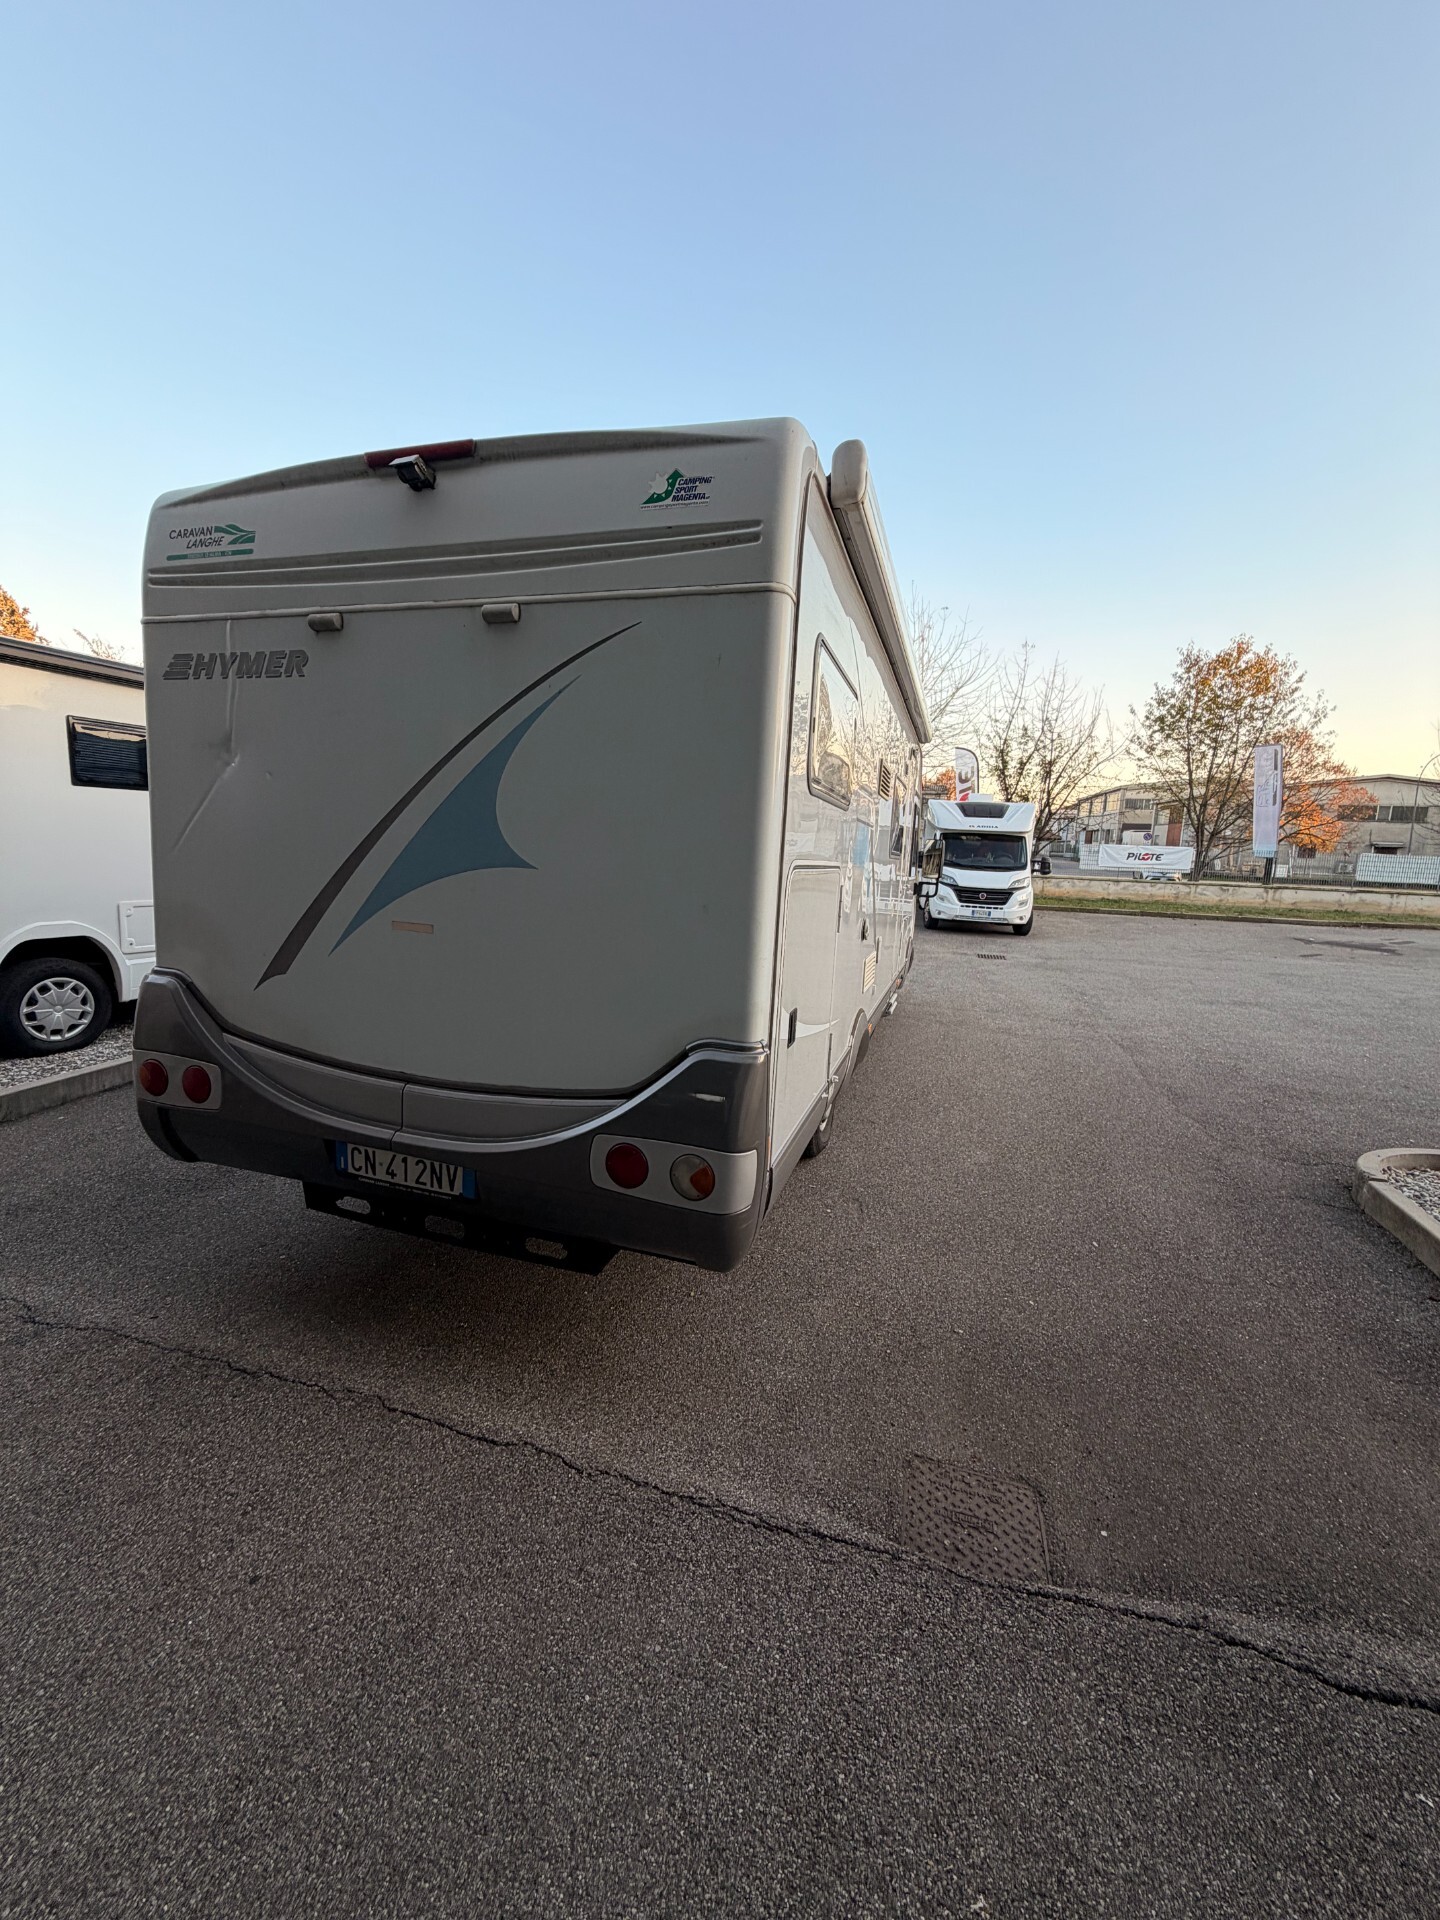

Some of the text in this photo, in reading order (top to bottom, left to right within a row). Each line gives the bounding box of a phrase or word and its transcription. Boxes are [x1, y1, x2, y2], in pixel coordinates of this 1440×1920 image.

[678, 476, 713, 486] CAMPING
[674, 486, 698, 494] SPORT
[671, 493, 706, 502] MAGENTA
[169, 526, 213, 540] CARAVAN
[186, 536, 225, 549] LANGHE
[191, 650, 309, 680] HYMER
